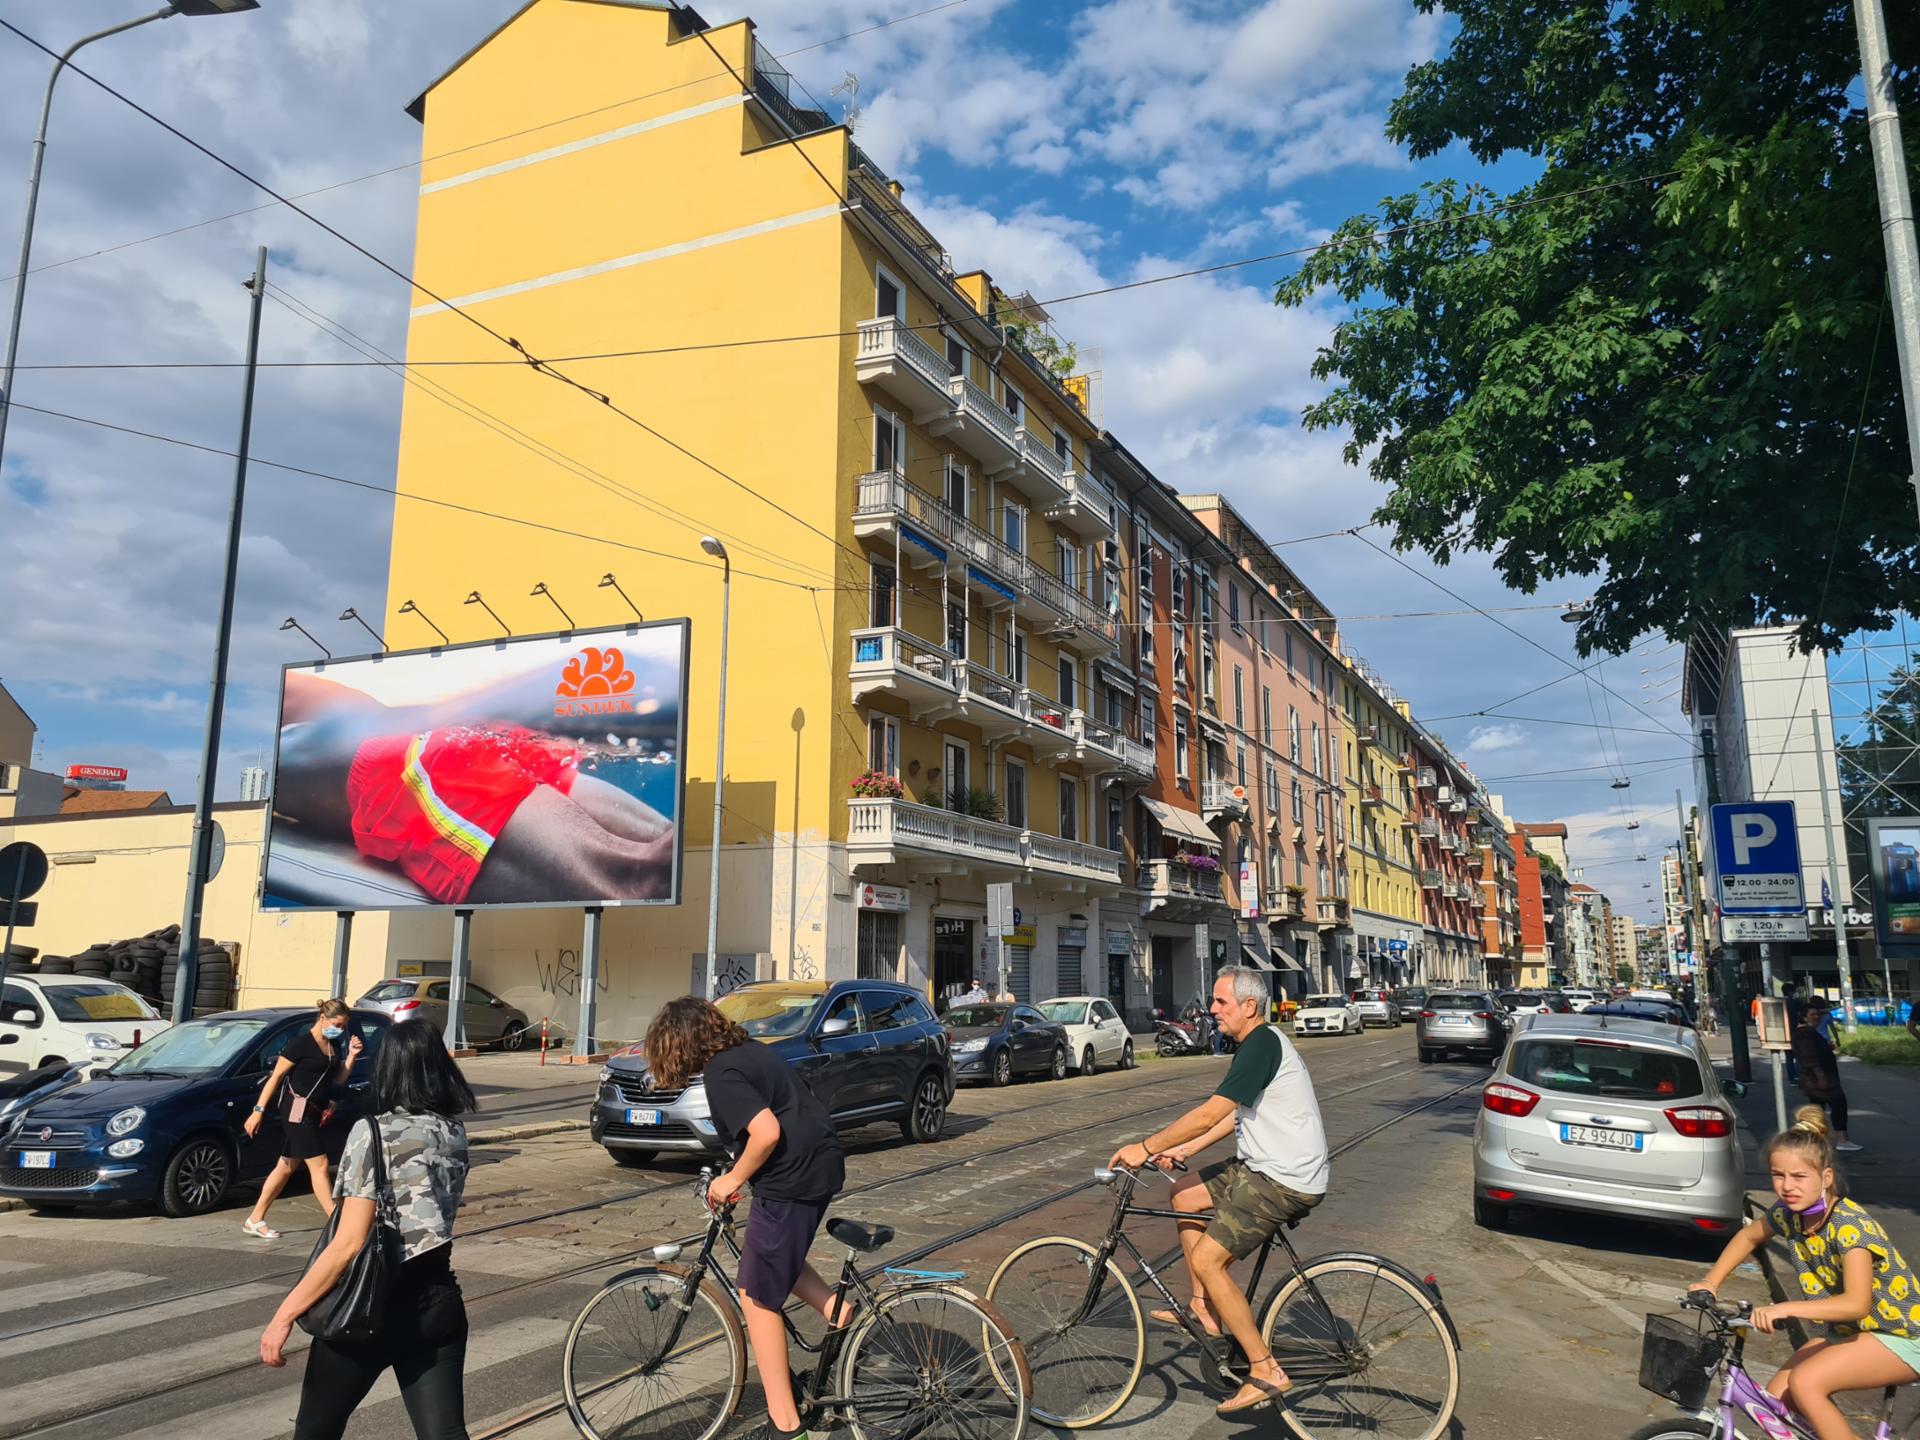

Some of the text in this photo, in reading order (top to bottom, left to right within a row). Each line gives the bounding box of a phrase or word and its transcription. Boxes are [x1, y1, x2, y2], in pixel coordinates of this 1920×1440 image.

[554, 699, 634, 717] SUNDEK
[80, 767, 121, 777] GENERALI
[1730, 813, 1777, 865] P
[1571, 1127, 1633, 1146] EZ 994JD
